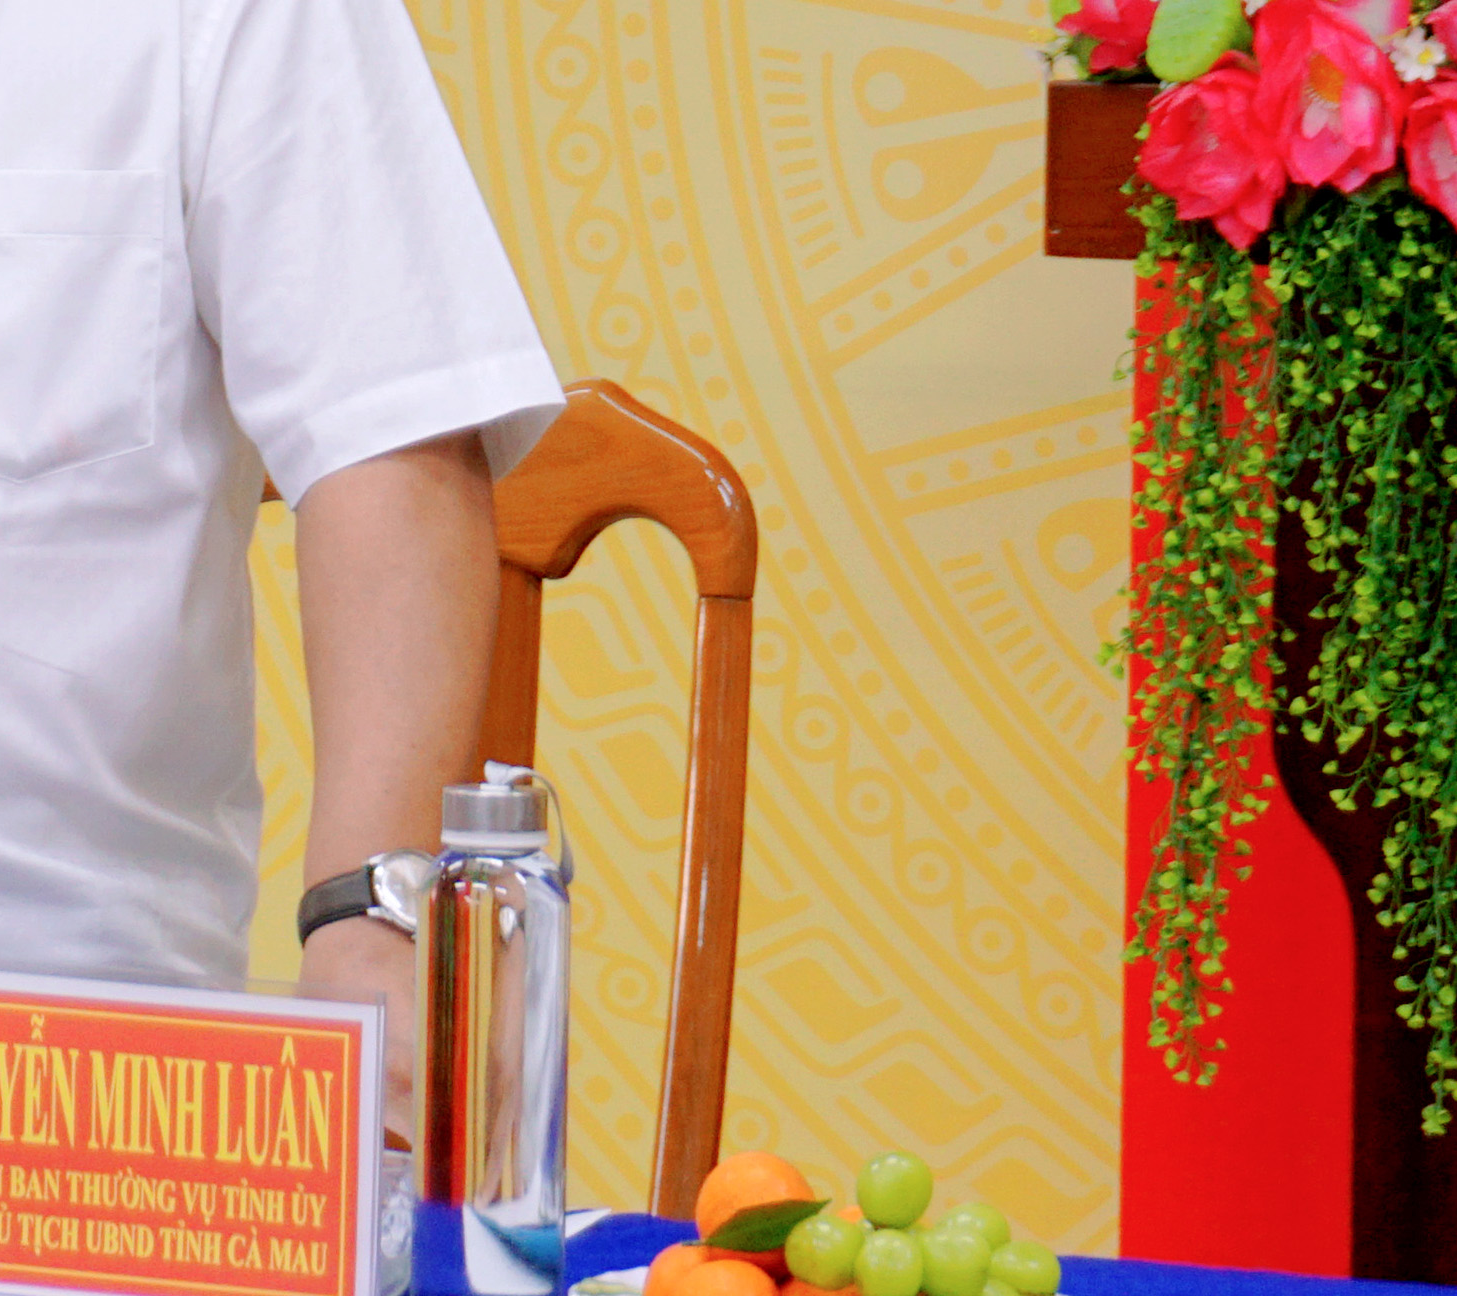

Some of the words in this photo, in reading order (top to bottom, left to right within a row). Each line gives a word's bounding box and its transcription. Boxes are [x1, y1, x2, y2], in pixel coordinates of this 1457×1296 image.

[87, 1050, 207, 1161] MINH
[215, 1035, 334, 1174] LUÂN
[9, 1164, 62, 1203] BAN
[66, 1166, 177, 1214] THƯỜNG
[181, 1180, 218, 1226] VỤ
[223, 1180, 285, 1225] TỈNH
[290, 1180, 327, 1228] ỦY
[17, 1216, 80, 1256] TỊCH
[86, 1220, 155, 1260] UBND
[159, 1224, 221, 1266] TỈNH
[227, 1225, 262, 1265] CÀ
[267, 1240, 328, 1276] MAU
